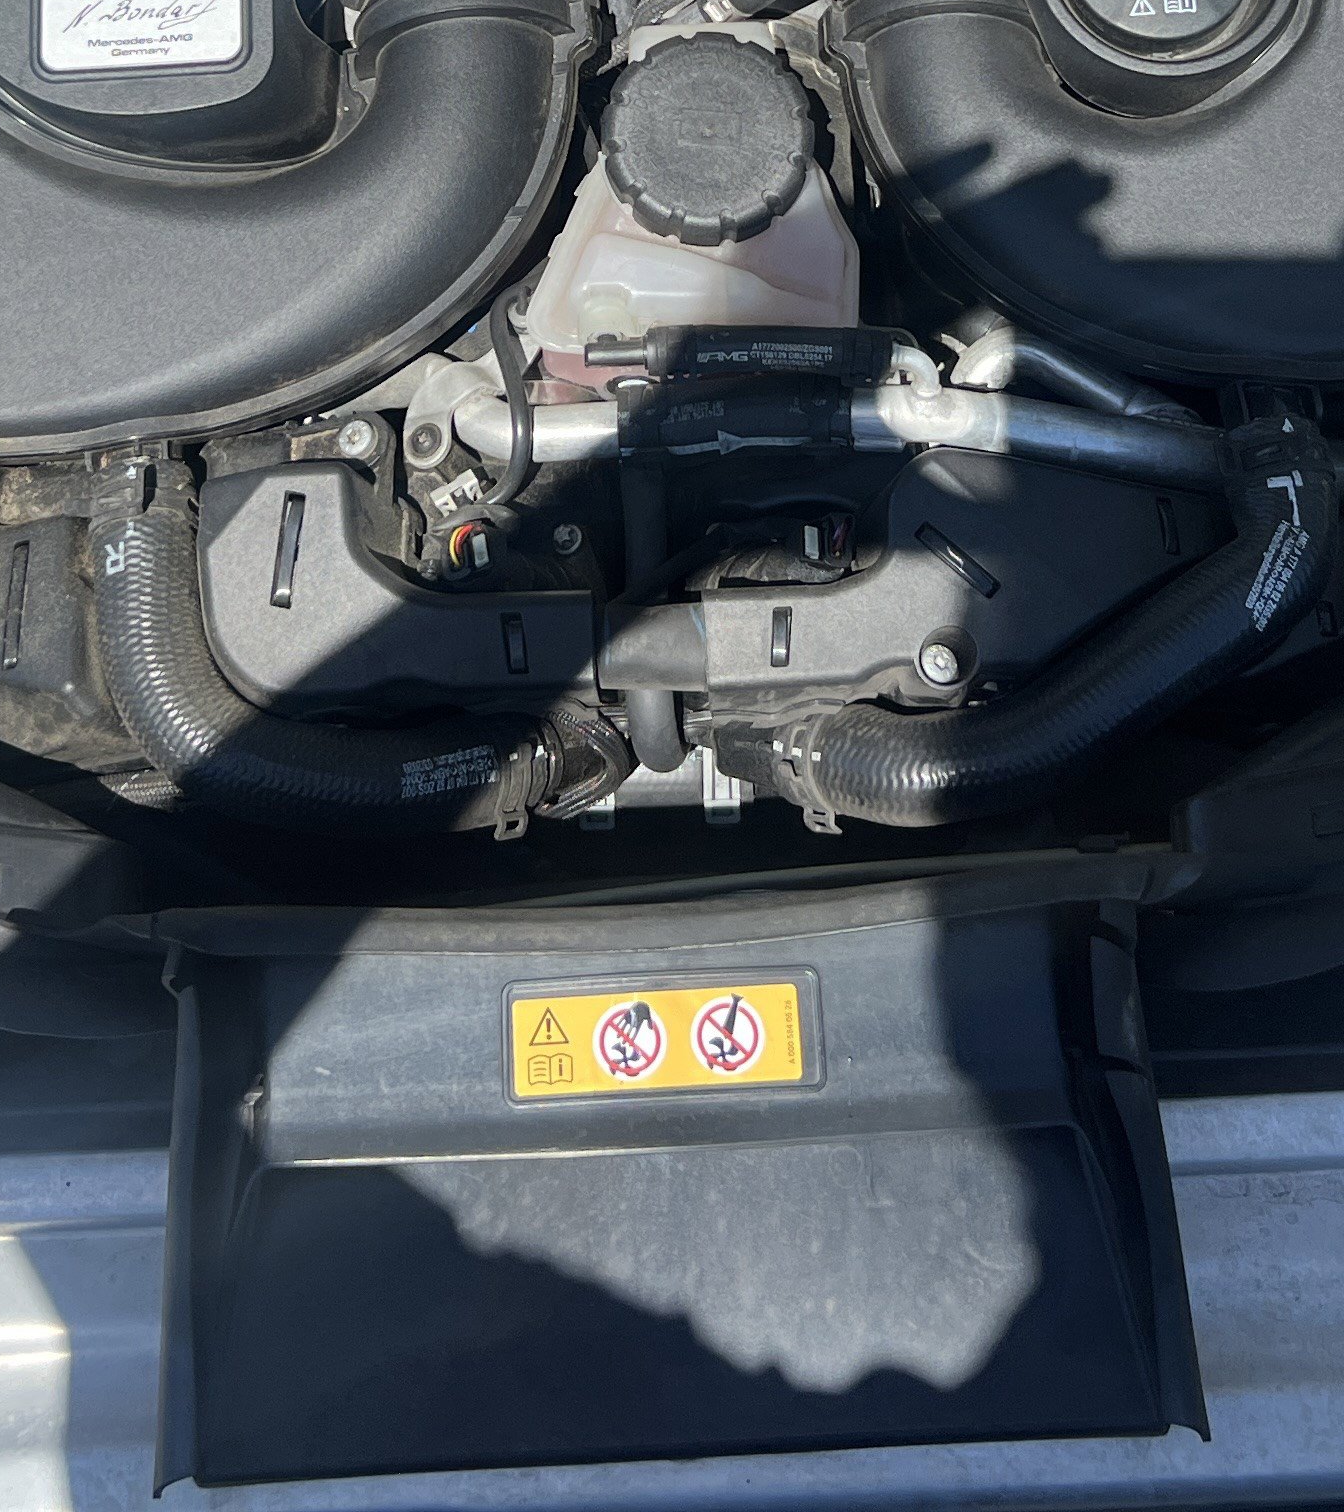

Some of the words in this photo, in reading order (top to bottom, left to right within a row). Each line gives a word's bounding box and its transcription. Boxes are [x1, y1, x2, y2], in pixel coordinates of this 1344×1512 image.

[87, 32, 194, 48] Mercedes-AMG
[110, 45, 172, 57] Germany
[704, 350, 749, 362] AMG
